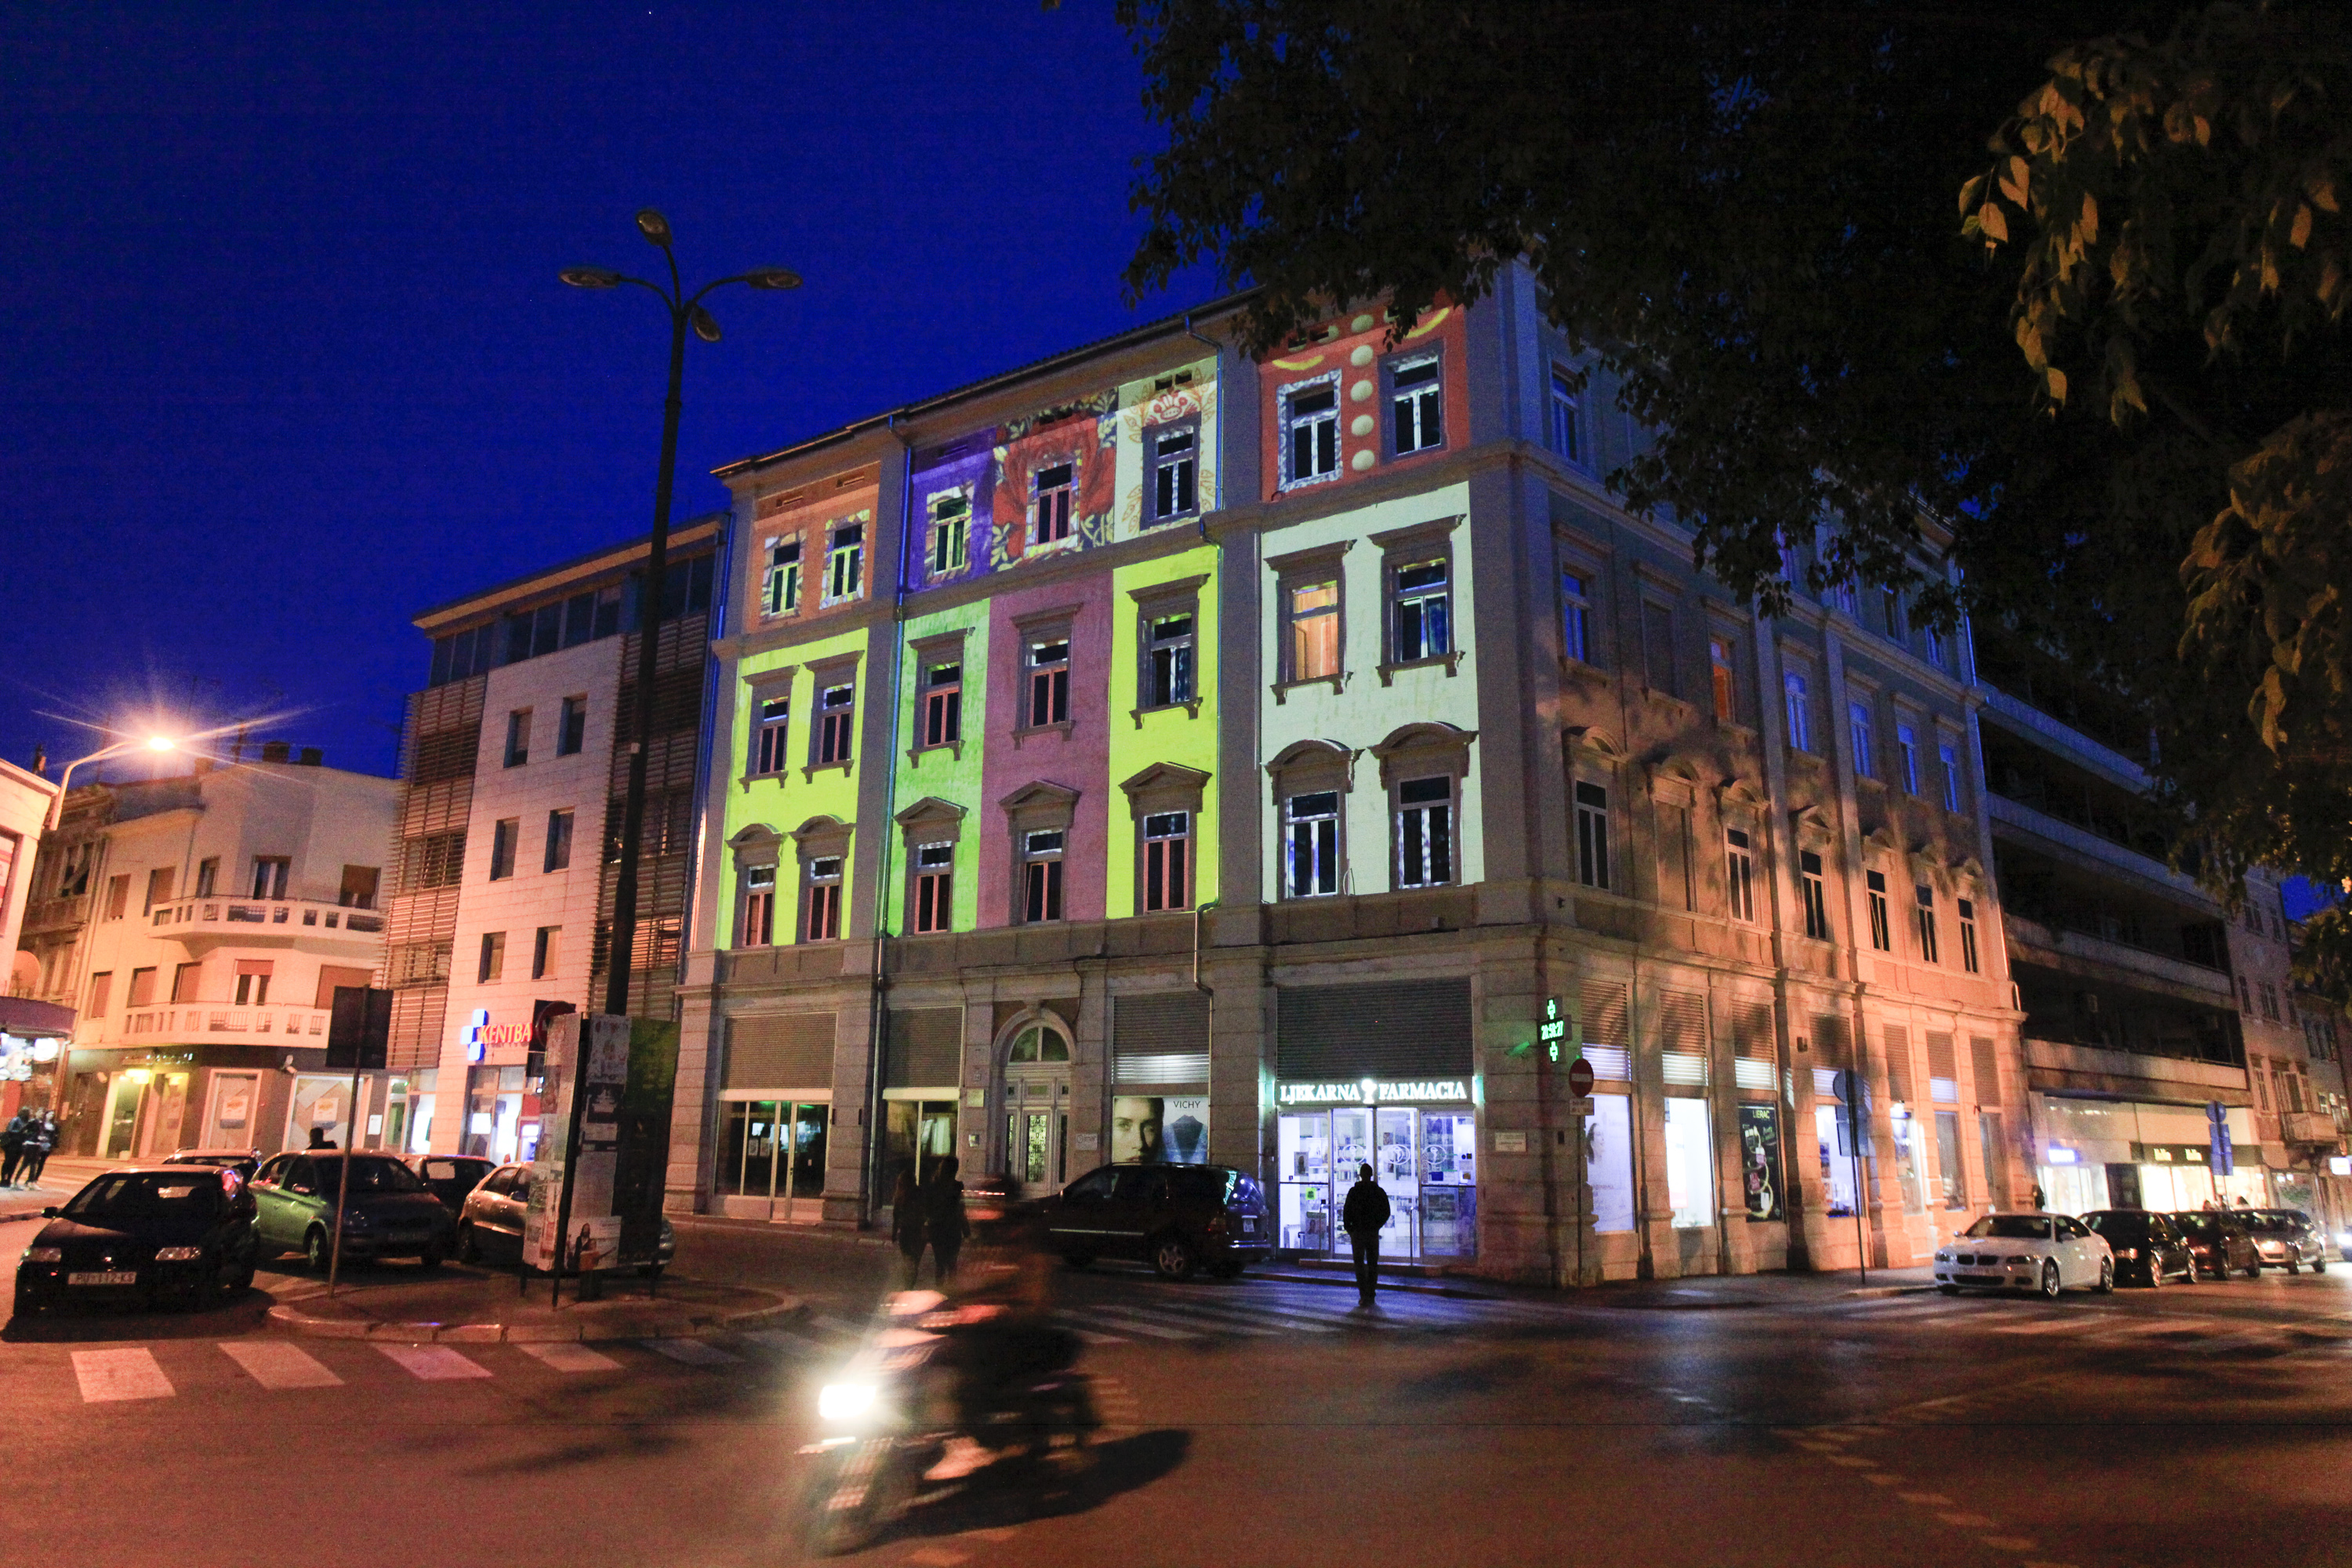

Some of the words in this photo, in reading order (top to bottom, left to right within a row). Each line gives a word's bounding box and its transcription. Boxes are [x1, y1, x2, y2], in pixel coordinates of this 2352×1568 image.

[1279, 1084, 1361, 1105] LJEKARNA
[1379, 1082, 1467, 1100] FARMACIA
[1173, 1100, 1201, 1109] VICHY
[1752, 1109, 1770, 1120] LIERAC
